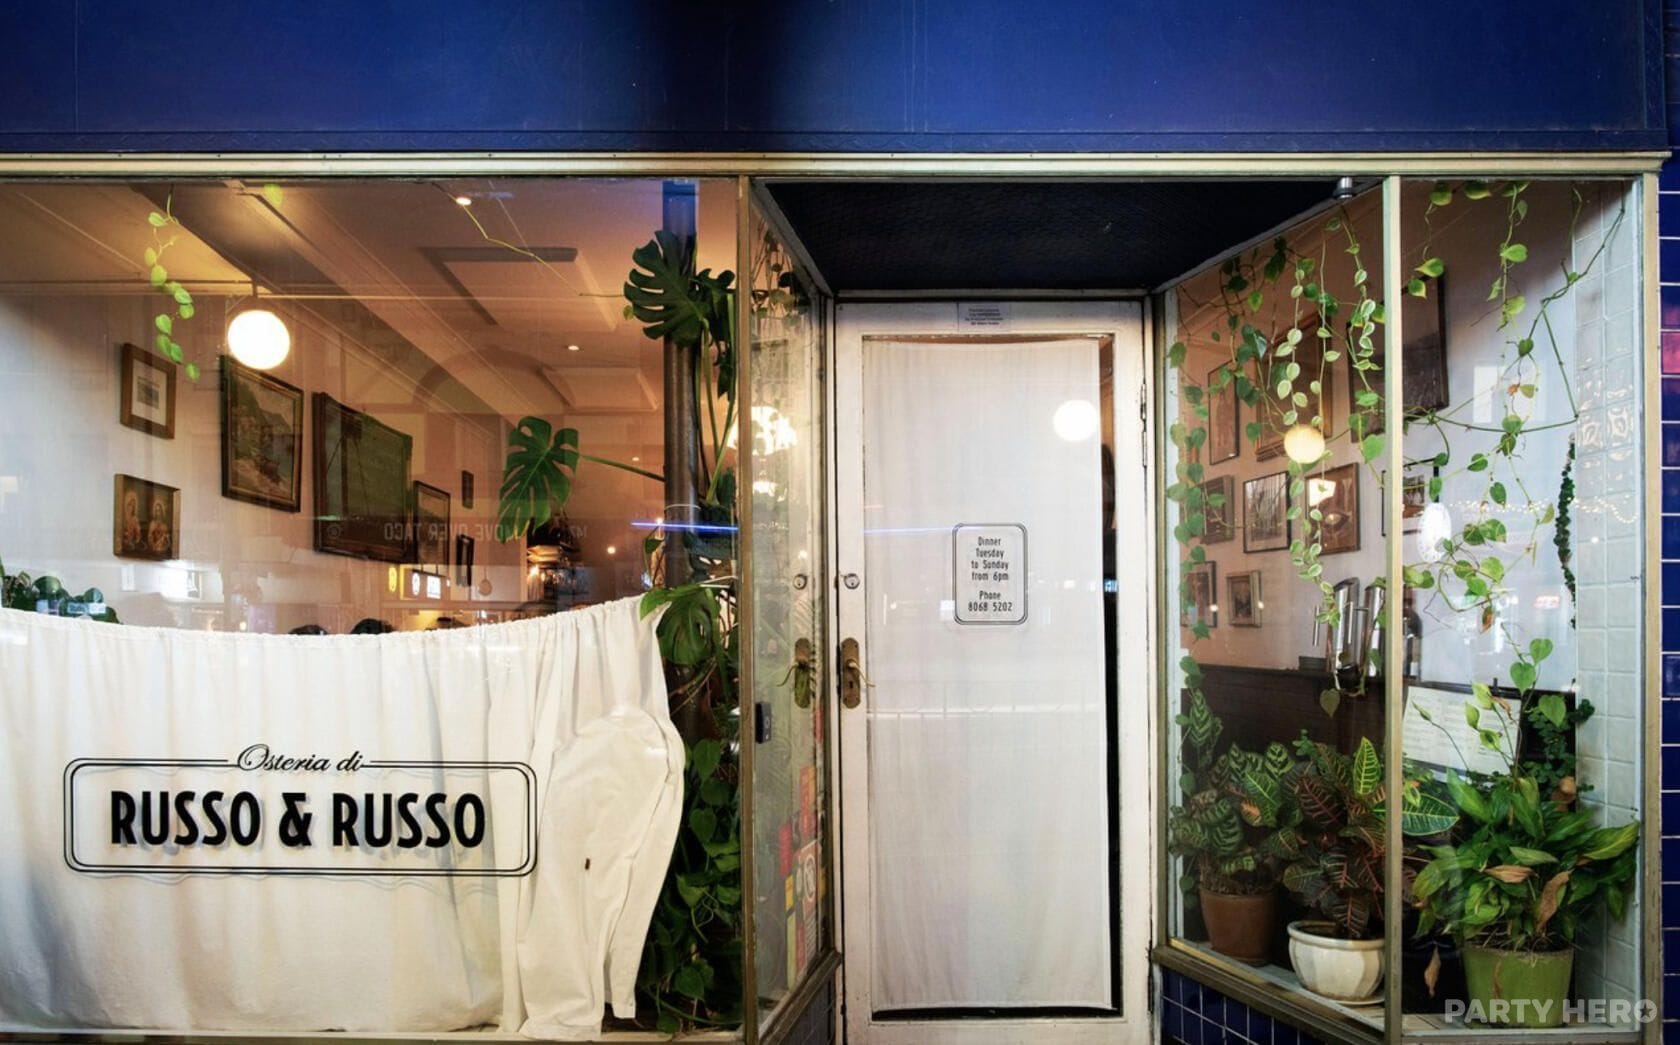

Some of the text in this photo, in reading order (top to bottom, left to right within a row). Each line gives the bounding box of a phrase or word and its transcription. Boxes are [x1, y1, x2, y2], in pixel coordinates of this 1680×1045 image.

[977, 536, 1001, 546] Dinner
[976, 548, 1004, 558] Tuesday
[971, 560, 1009, 570] to Sunday
[972, 572, 1009, 581] from 6pm
[979, 590, 1001, 599] Phone
[968, 602, 1012, 611] 8068 5202
[237, 743, 363, 773] Osteria di
[110, 790, 486, 849] RUSSO & RUSSO
